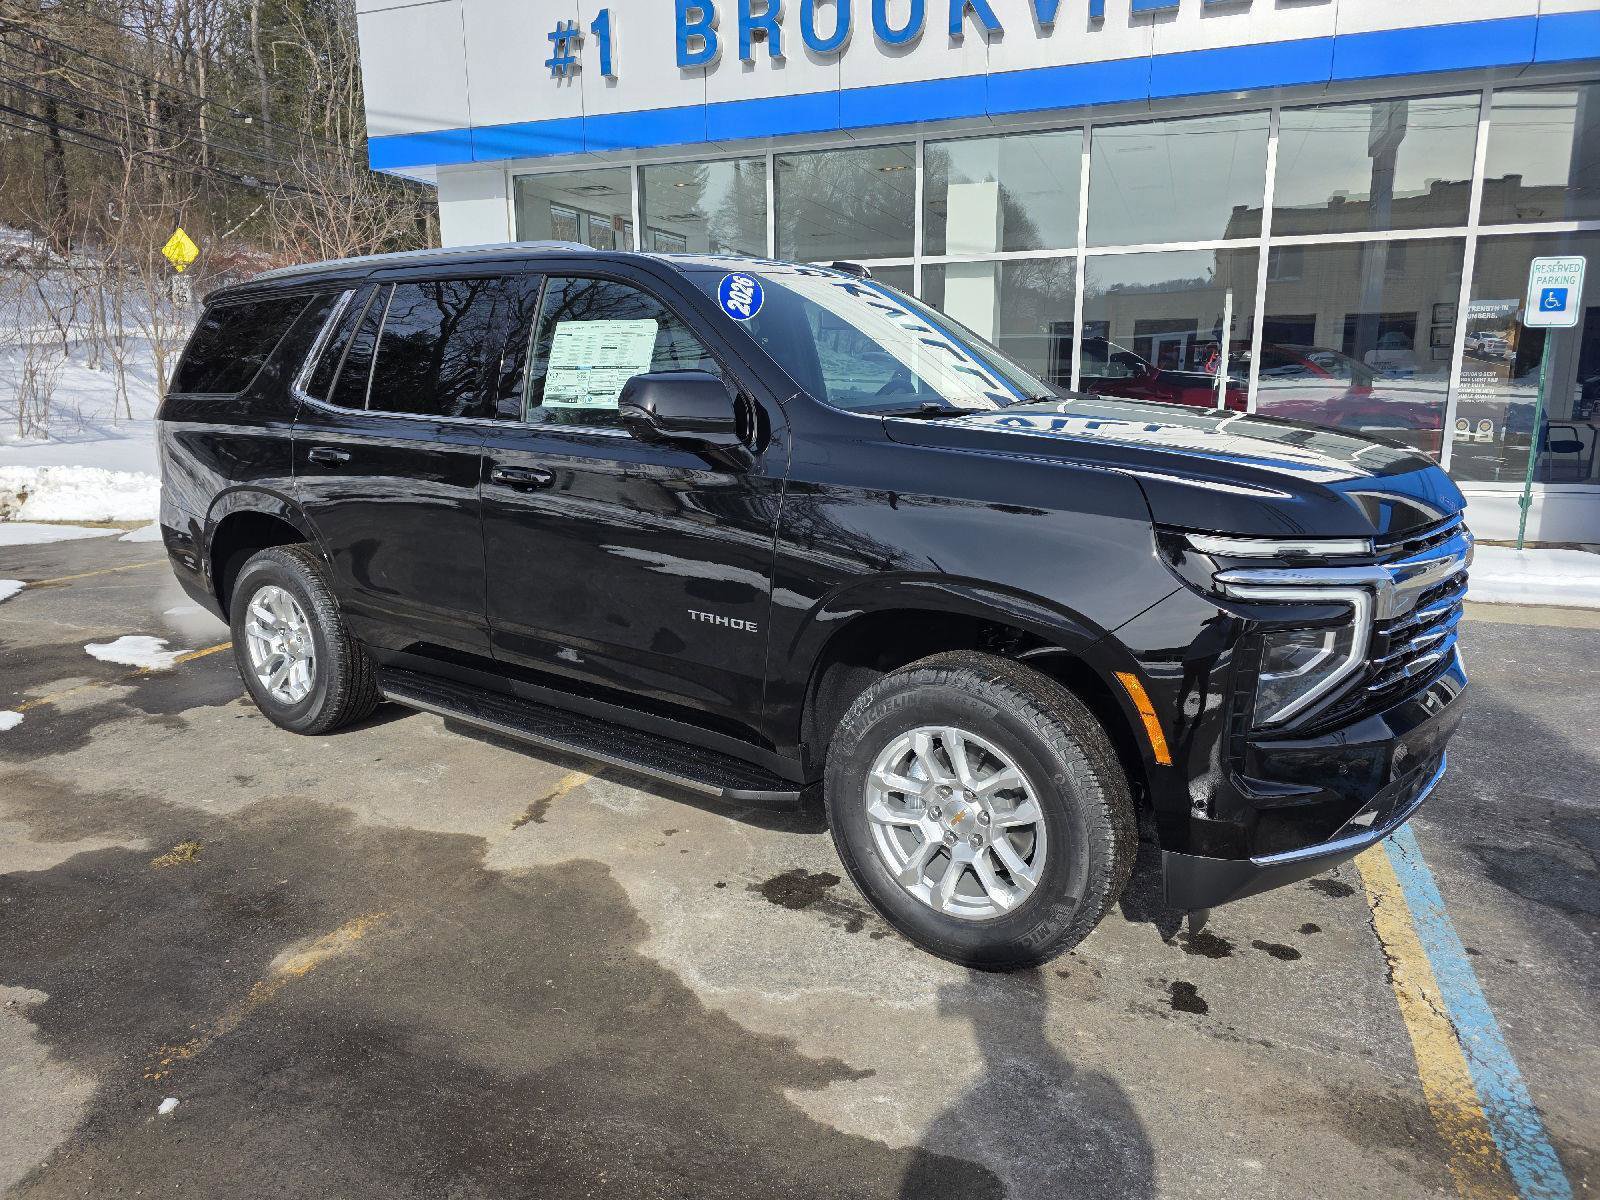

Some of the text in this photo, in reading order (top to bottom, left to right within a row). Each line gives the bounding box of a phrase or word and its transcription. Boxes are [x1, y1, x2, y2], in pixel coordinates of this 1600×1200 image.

[545, 8, 613, 77] #1
[1535, 263, 1581, 273] RESERVED
[1536, 275, 1576, 285] PARKING
[726, 275, 755, 317] 2026
[1467, 304, 1500, 312] TRENGTH
[687, 609, 758, 633] TAHOE
